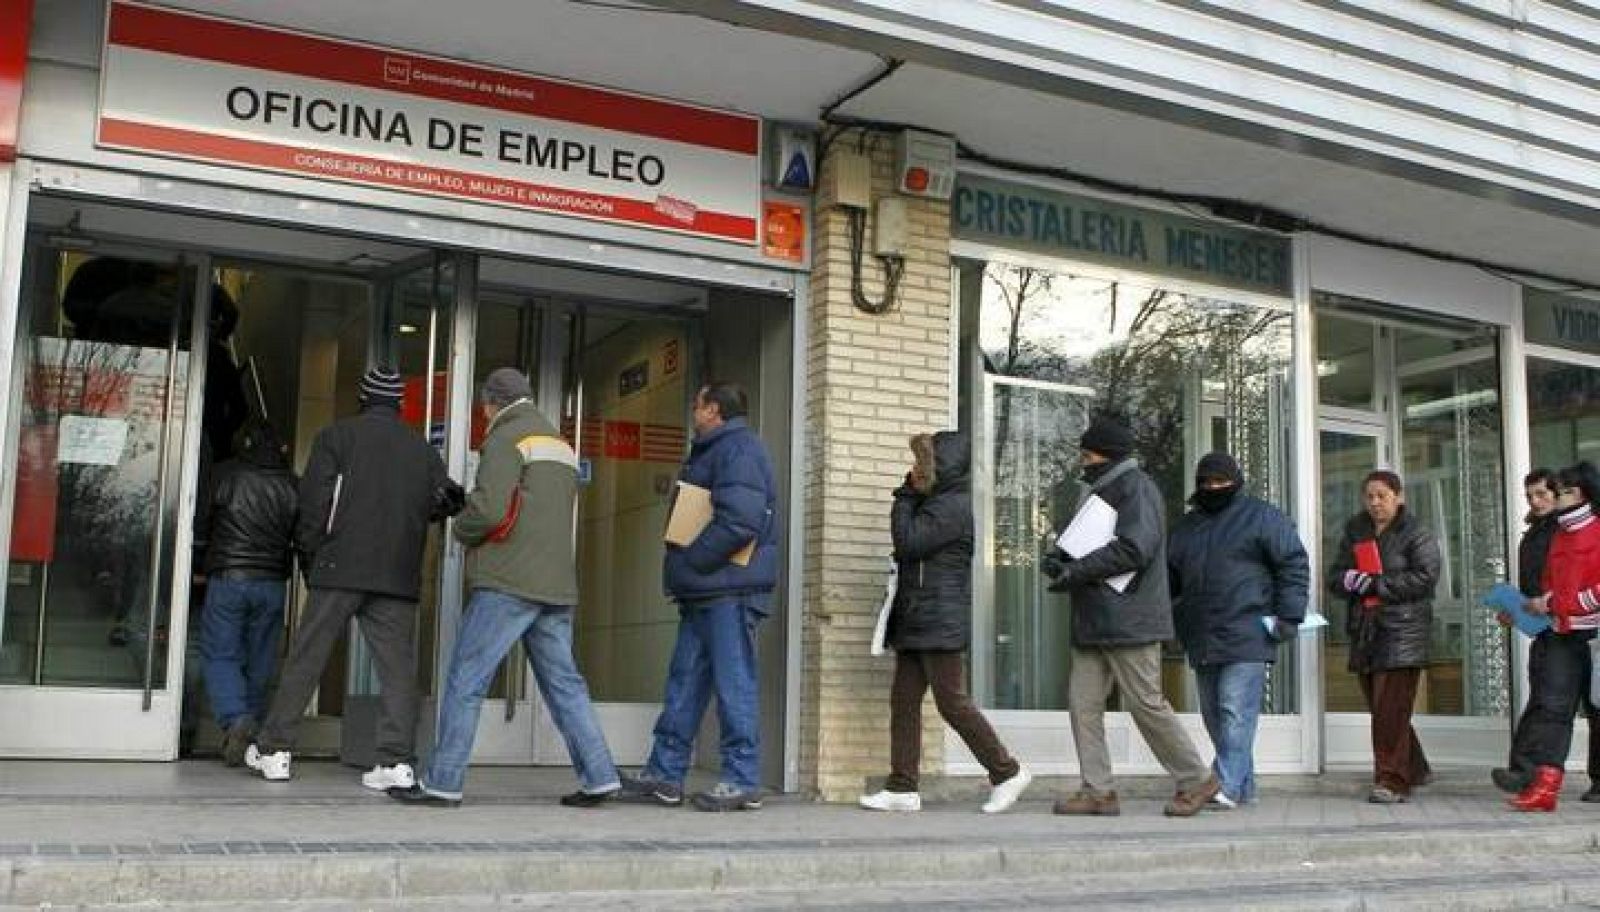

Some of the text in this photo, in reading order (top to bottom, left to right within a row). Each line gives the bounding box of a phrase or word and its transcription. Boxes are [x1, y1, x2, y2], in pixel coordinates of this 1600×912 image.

[226, 86, 665, 186] OFICINA DE EMPLEO
[386, 167, 408, 179] DE
[470, 179, 514, 198] MUJER
[517, 188, 527, 201] E
